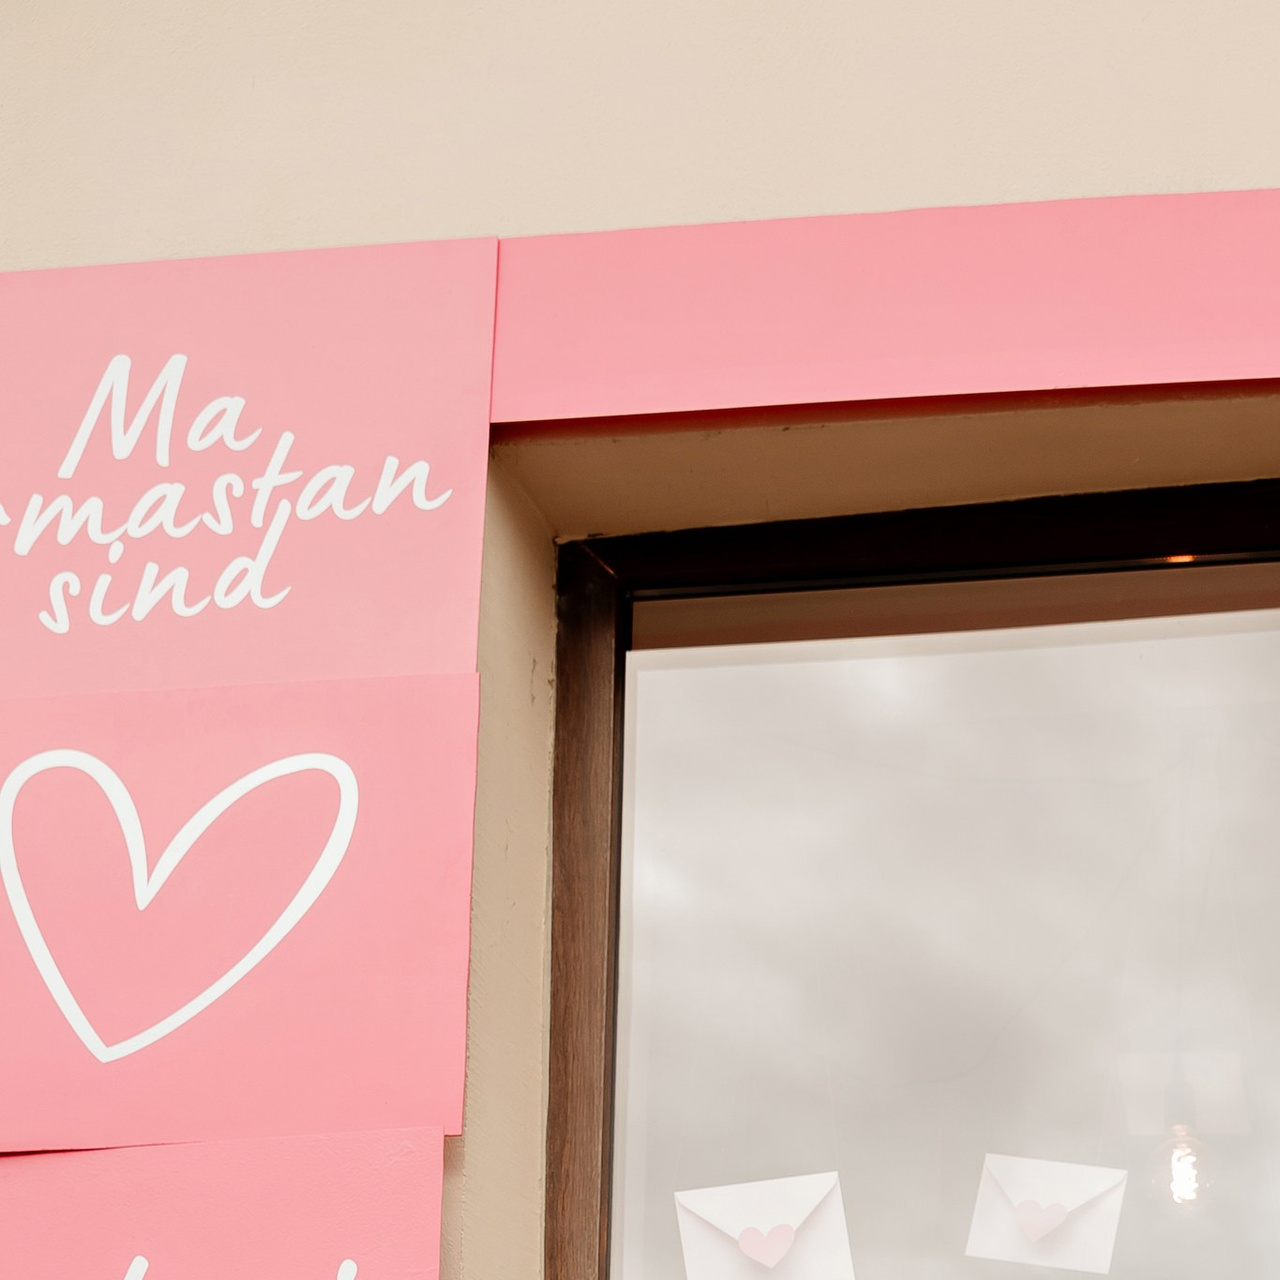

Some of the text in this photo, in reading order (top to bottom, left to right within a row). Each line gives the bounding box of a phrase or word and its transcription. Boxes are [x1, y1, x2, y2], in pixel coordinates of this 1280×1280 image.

[58, 354, 262, 479] Ma
[0, 431, 453, 563] mastan
[38, 499, 292, 634] sind
